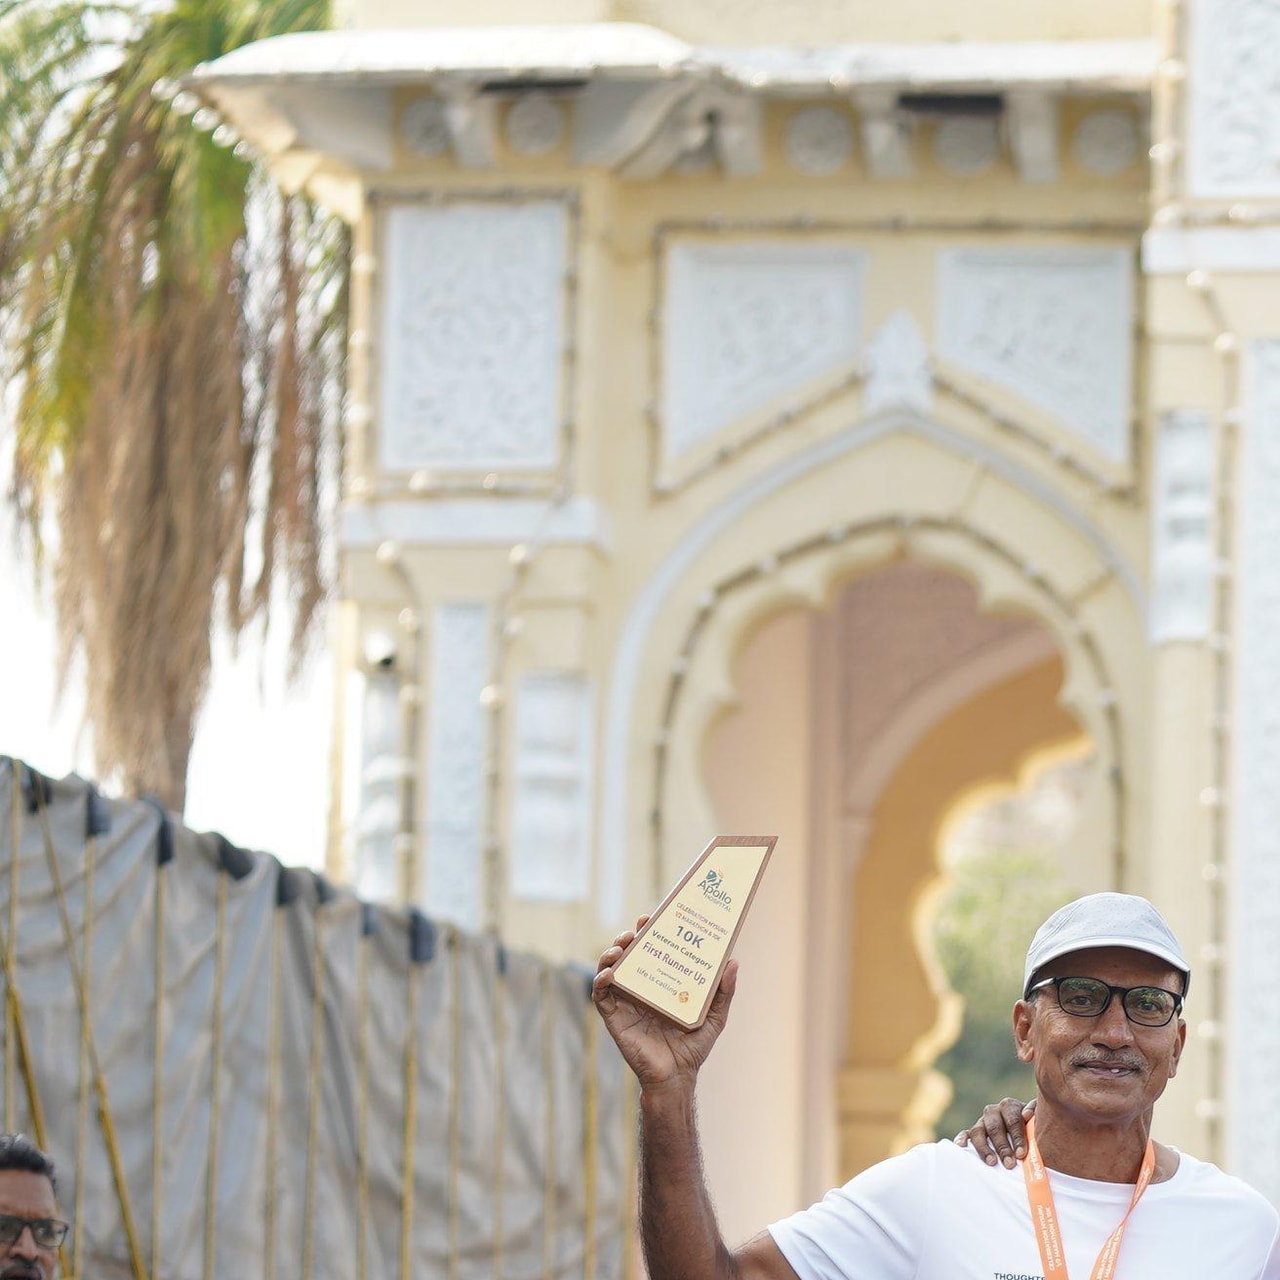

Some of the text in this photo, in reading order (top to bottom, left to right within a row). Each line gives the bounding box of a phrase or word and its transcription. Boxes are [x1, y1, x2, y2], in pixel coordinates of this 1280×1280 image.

[698, 880, 732, 905] Apollo
[652, 930, 713, 970] Veteran Category
[676, 925, 704, 948] 10K
[642, 941, 706, 985] First Runner Up
[637, 967, 649, 979] life
[655, 978, 678, 996] calling
